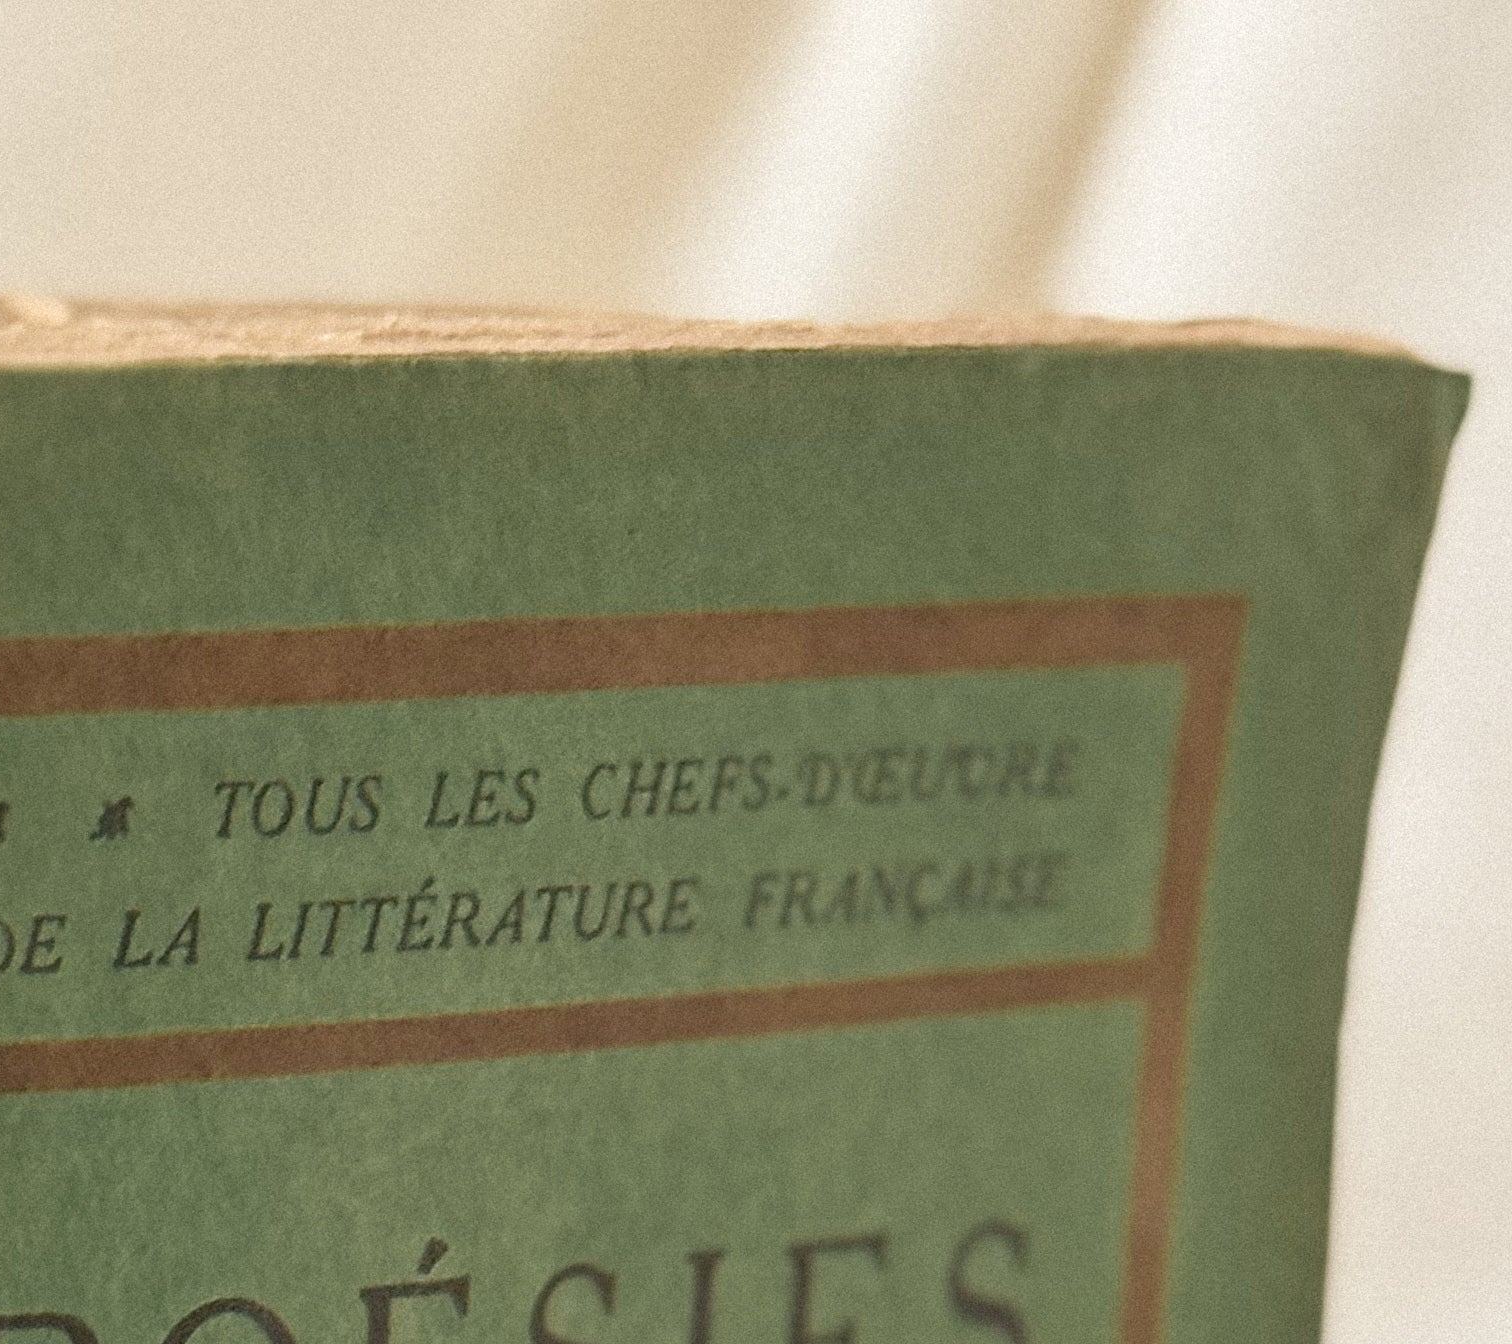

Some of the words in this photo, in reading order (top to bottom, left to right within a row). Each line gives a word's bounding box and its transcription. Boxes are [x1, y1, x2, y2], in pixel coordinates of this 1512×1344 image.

[213, 773, 385, 842] TOUS
[423, 766, 542, 833] LES
[109, 906, 203, 970] LA
[246, 874, 701, 965] LITTÉRATURE
[740, 849, 1071, 931] FRANÇAISE
